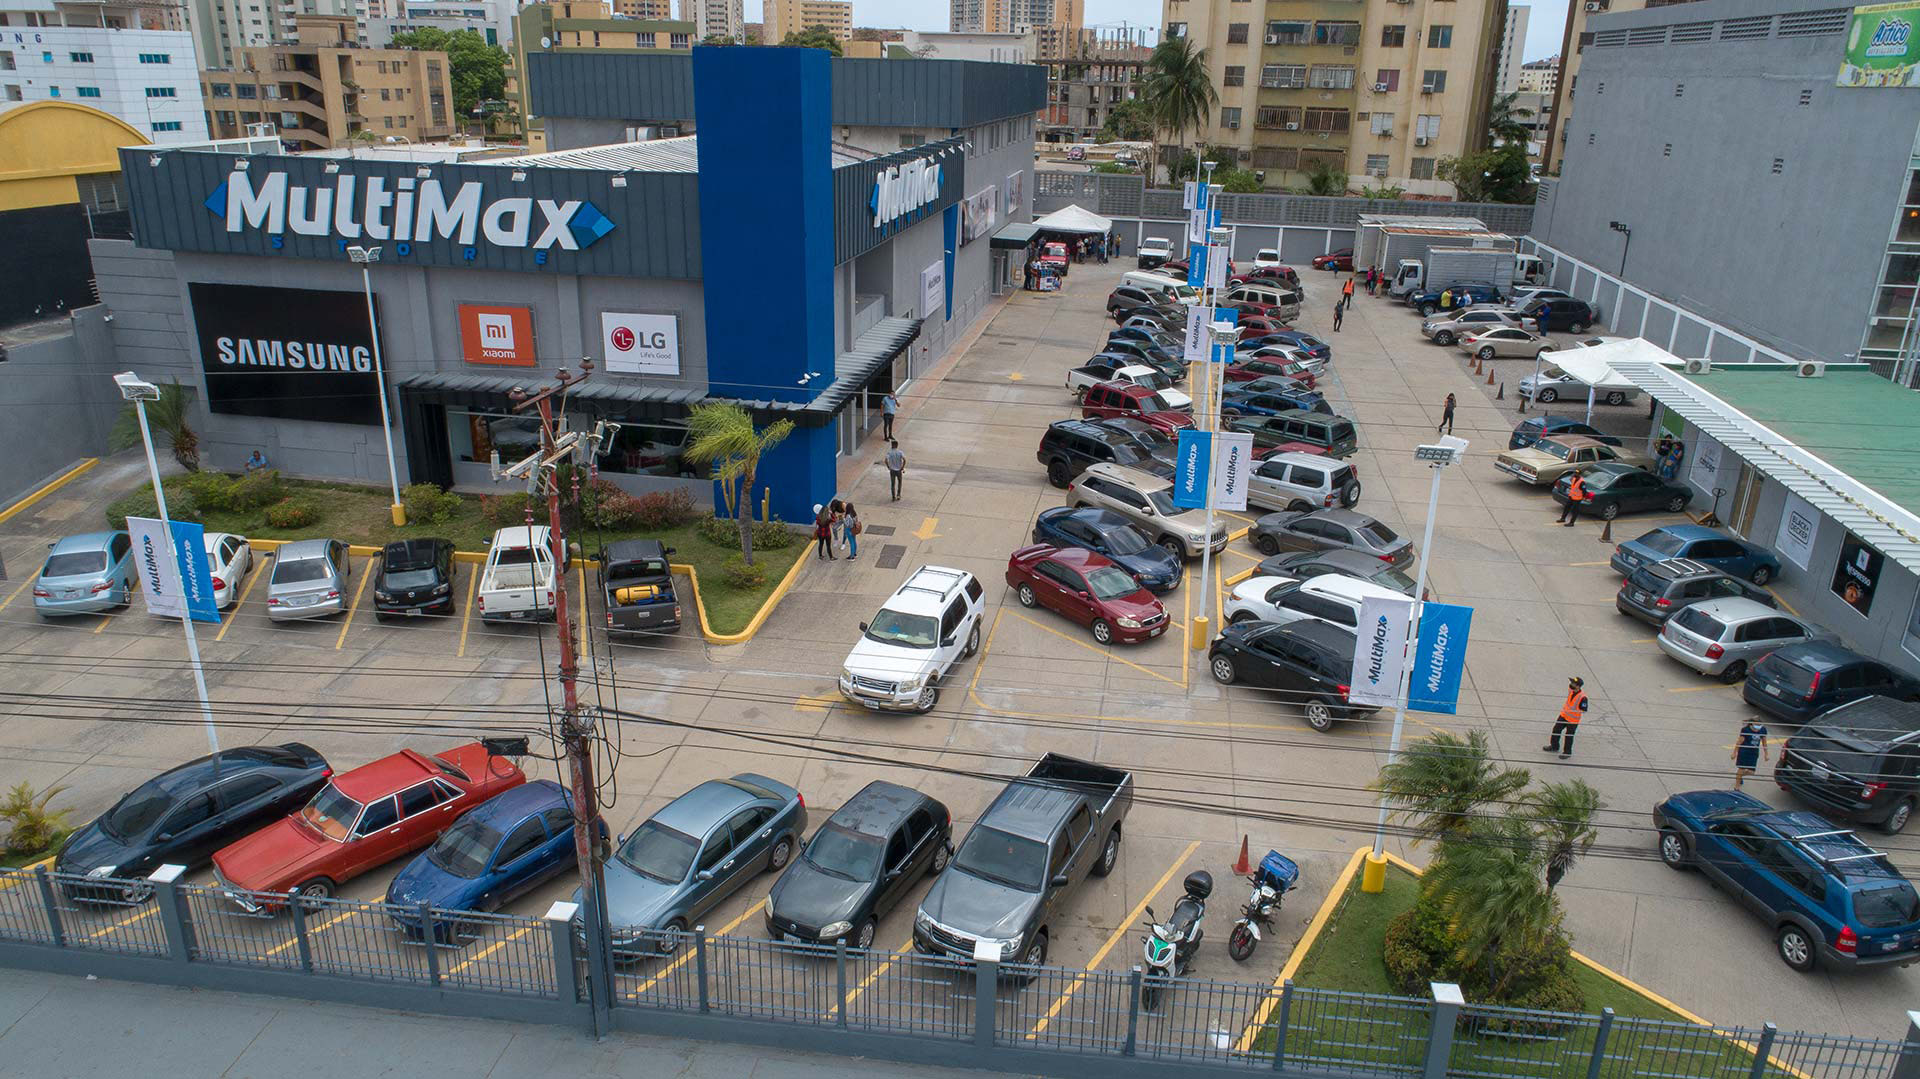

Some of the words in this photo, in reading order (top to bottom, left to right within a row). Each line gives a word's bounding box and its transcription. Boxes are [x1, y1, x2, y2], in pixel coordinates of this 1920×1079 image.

[226, 170, 582, 251] MultiMax
[271, 237, 549, 265] STORE
[217, 336, 372, 373] SAMSUNG
[482, 349, 516, 359] xiaomi
[639, 332, 666, 349] LG
[656, 352, 672, 360] Good
[1185, 446, 1198, 493] MultiMax
[1226, 450, 1238, 493] MultiMax
[143, 540, 162, 594] MultiMax
[184, 543, 201, 600] MultiMax
[1368, 620, 1388, 682] MultiMax
[1427, 627, 1449, 691] MultiMax
